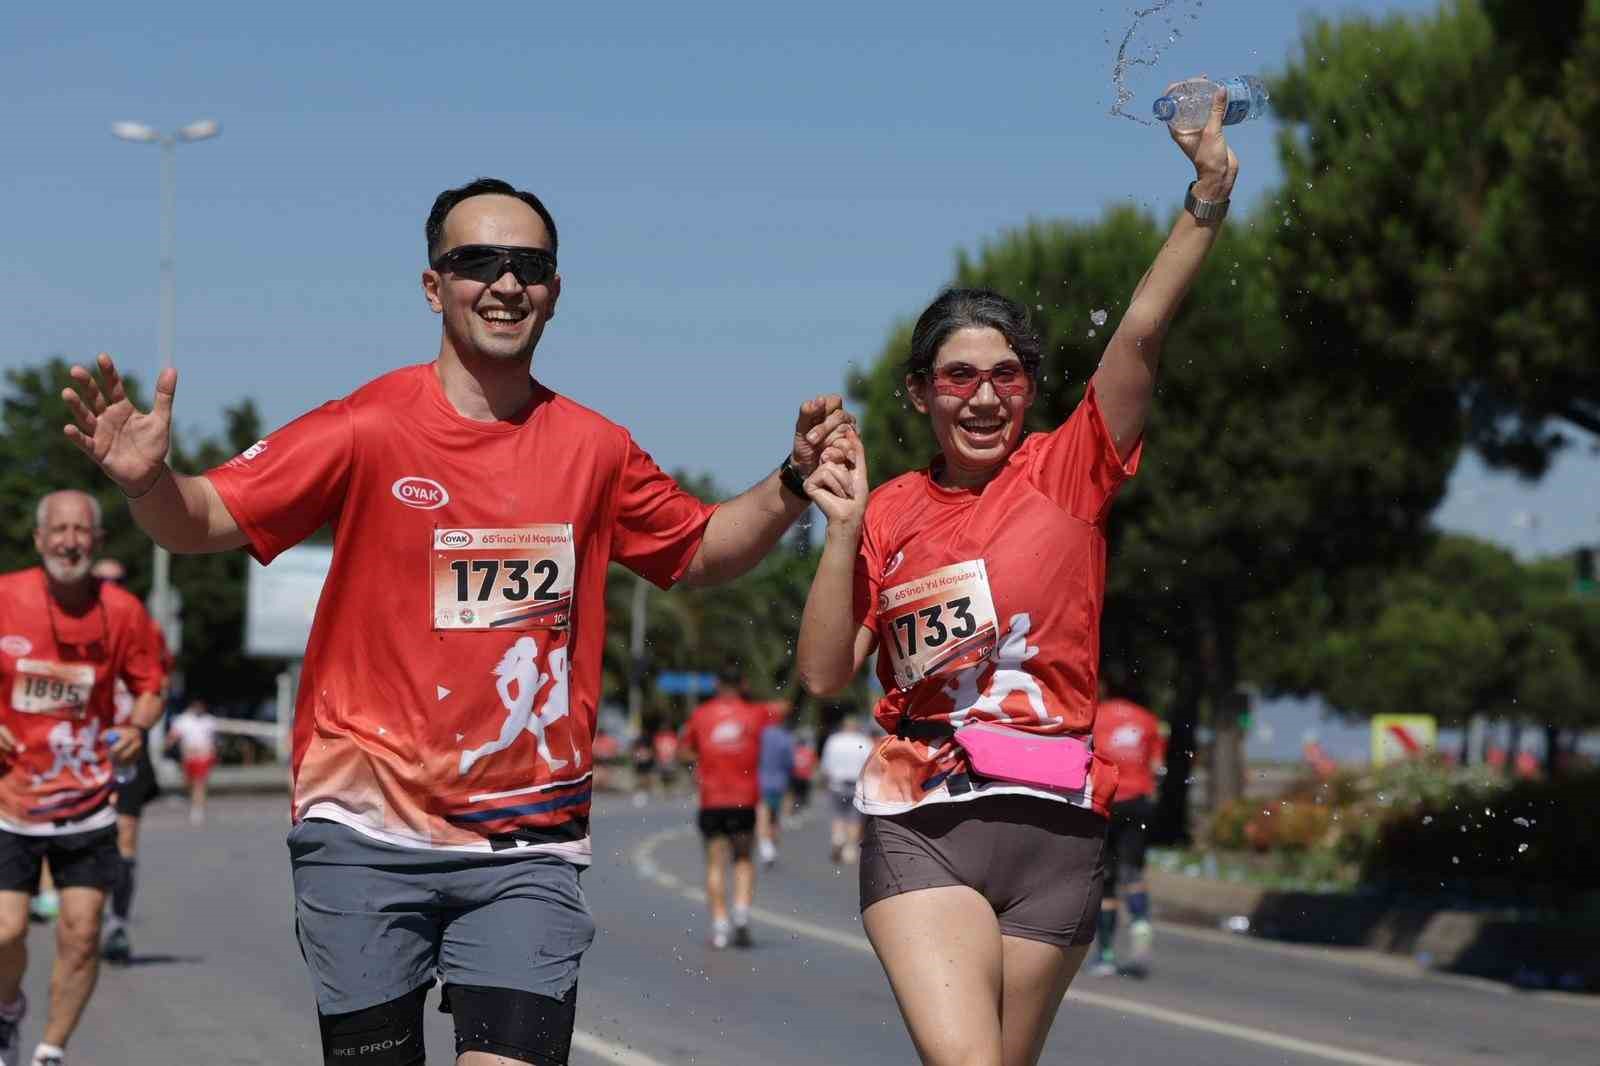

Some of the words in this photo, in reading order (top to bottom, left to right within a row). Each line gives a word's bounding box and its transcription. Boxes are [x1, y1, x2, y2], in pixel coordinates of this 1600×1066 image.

[402, 484, 439, 501] OYAK
[445, 535, 468, 543] OYAK
[482, 533, 516, 544] 65'inci
[533, 533, 567, 546] Koşusu
[451, 559, 560, 601] 1732
[24, 676, 80, 704] 1895
[360, 1040, 392, 1055] PRO
